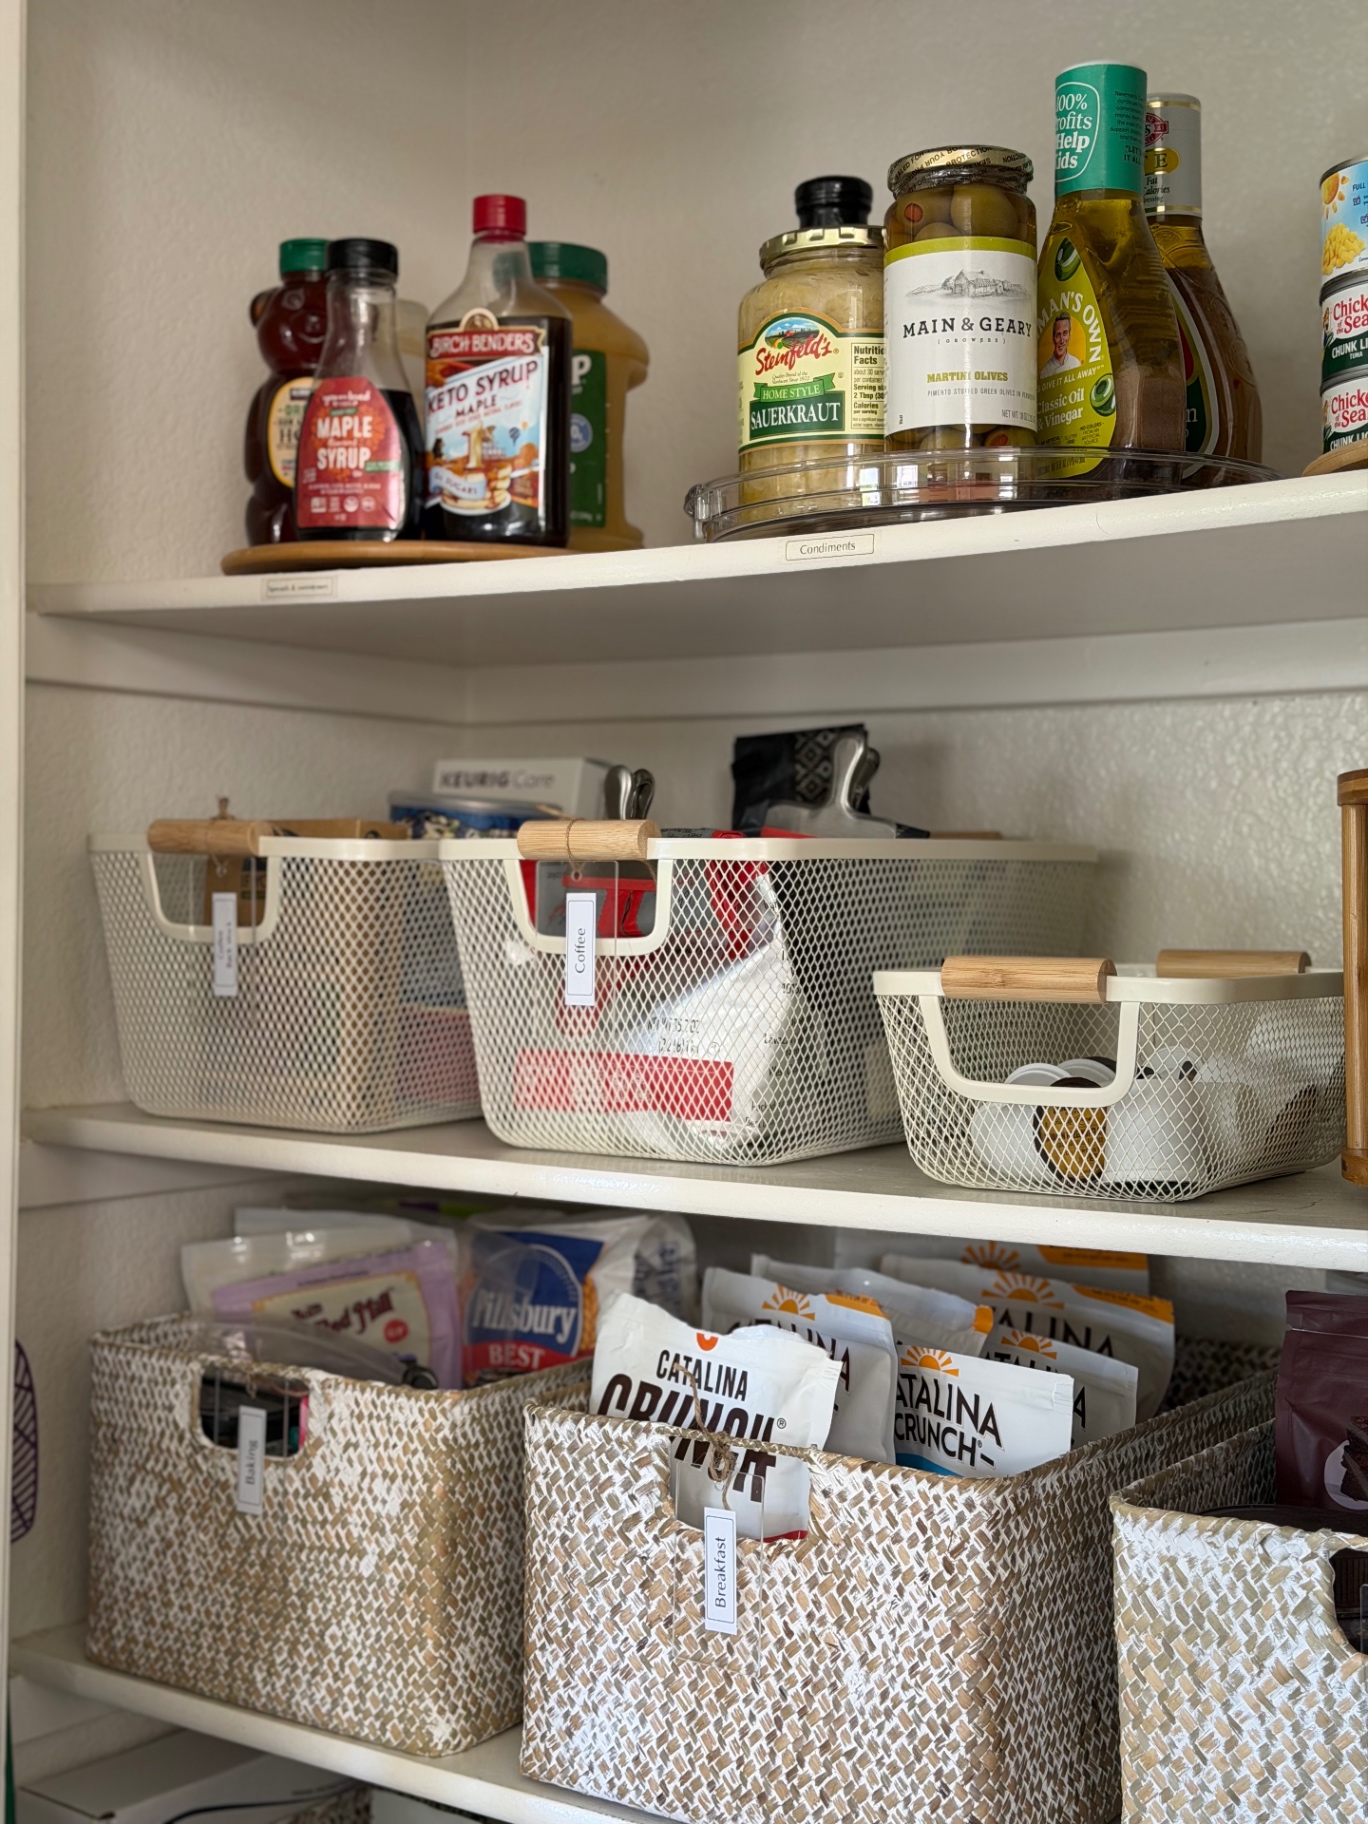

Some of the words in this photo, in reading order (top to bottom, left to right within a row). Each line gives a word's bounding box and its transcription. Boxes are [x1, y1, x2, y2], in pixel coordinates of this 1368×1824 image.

[1056, 112, 1093, 131] rofits
[1056, 152, 1079, 170] ids
[1352, 182, 1366, 192] FULL
[1332, 294, 1368, 321] Chick
[903, 318, 955, 338] MAIN
[961, 317, 974, 331] &
[979, 316, 1032, 337] GEARY
[1083, 304, 1102, 363] OWN
[430, 335, 470, 358] BIRCH
[472, 333, 535, 354] BENDERS
[755, 333, 832, 376] Steinfeld's
[1332, 340, 1357, 359] CHUNK
[853, 355, 878, 365] Facts
[427, 383, 469, 415] KETO
[475, 360, 538, 395] SYRUP
[853, 383, 877, 392] Serving
[927, 371, 971, 383] MARTINI
[974, 371, 1008, 382] OLIVES
[1042, 381, 1056, 391] GIVE
[1056, 377, 1063, 386] IT
[1063, 373, 1076, 384] ALL
[763, 389, 788, 400] HOME
[790, 384, 820, 398] STYLE
[859, 392, 874, 400] Tbsp
[928, 388, 951, 397] PIMENTO
[980, 388, 998, 396] GREEN
[1068, 387, 1085, 404] Oil
[455, 394, 497, 418] MAPLE
[750, 402, 841, 430] SAUERKRAUT
[853, 401, 879, 409] Calories
[317, 415, 373, 439] MAPLE
[1045, 407, 1083, 428] Vinegar
[1342, 408, 1367, 428] Sea
[316, 447, 371, 470] SYRUP
[800, 541, 856, 555] Condiments
[438, 770, 512, 789] KEURIG
[574, 927, 586, 974] Coffee
[472, 1288, 577, 1345] Pillsbury
[488, 1343, 546, 1370] BEST
[656, 1350, 749, 1402] CATALINA
[896, 1373, 1002, 1448] ATALINA
[894, 1412, 977, 1467] CRUNCH
[245, 1439, 259, 1486] Baking
[714, 1536, 727, 1609] Breakfast
